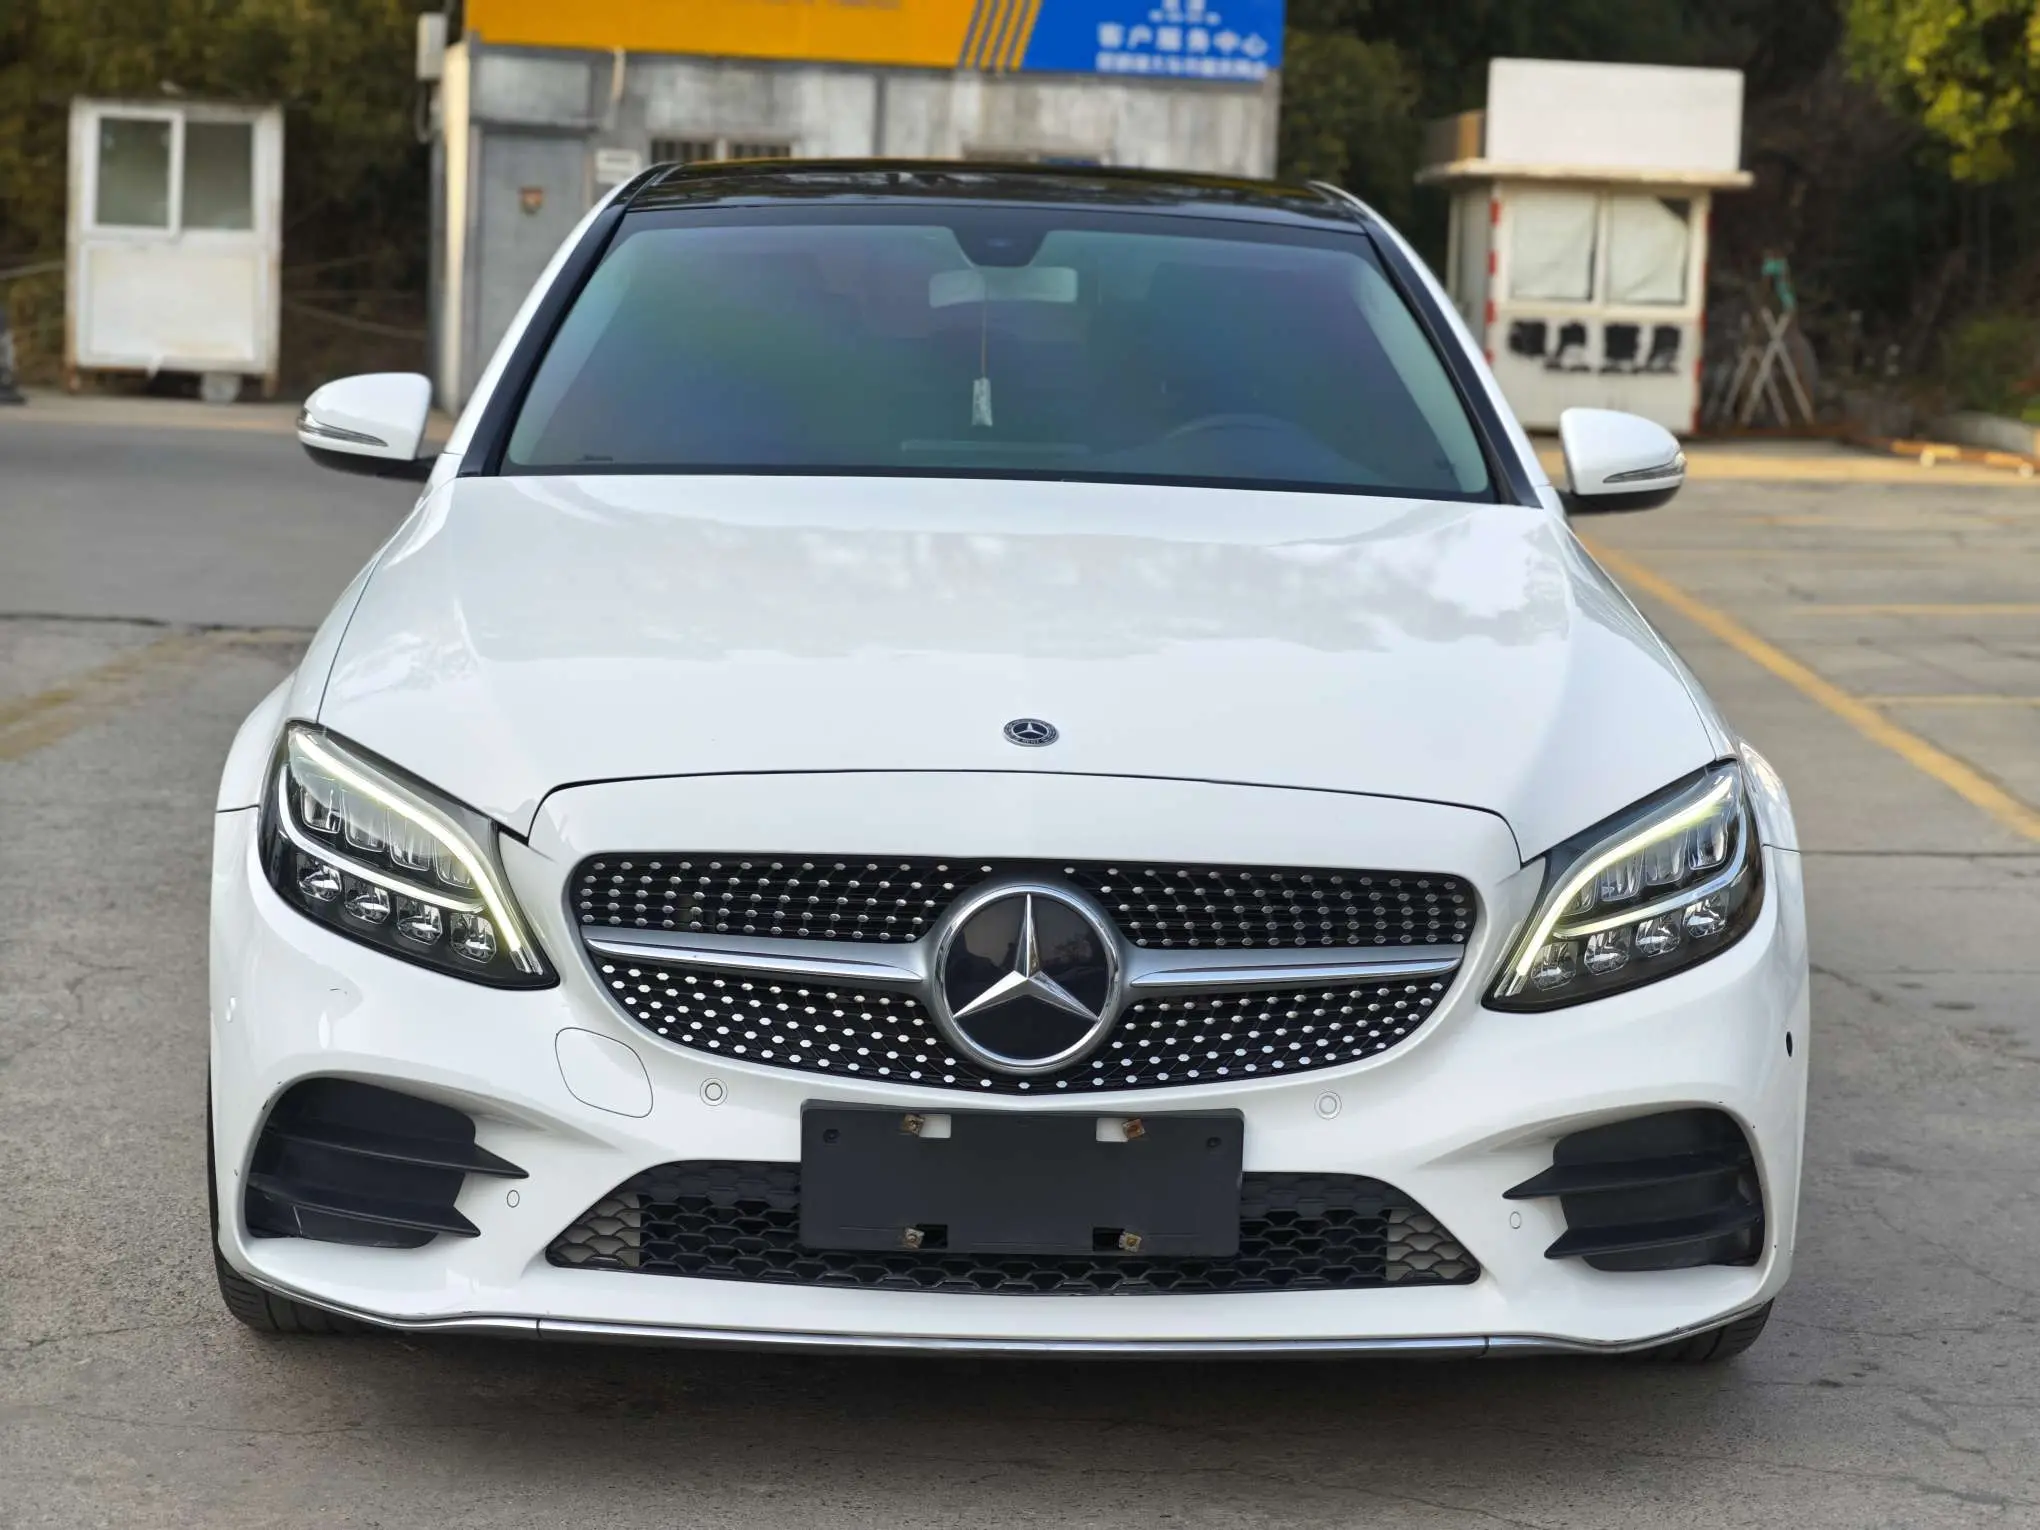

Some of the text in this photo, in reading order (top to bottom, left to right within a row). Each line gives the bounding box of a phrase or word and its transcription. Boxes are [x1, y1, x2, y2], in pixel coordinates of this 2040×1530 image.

[1097, 22, 1268, 58] 客户服务中心
